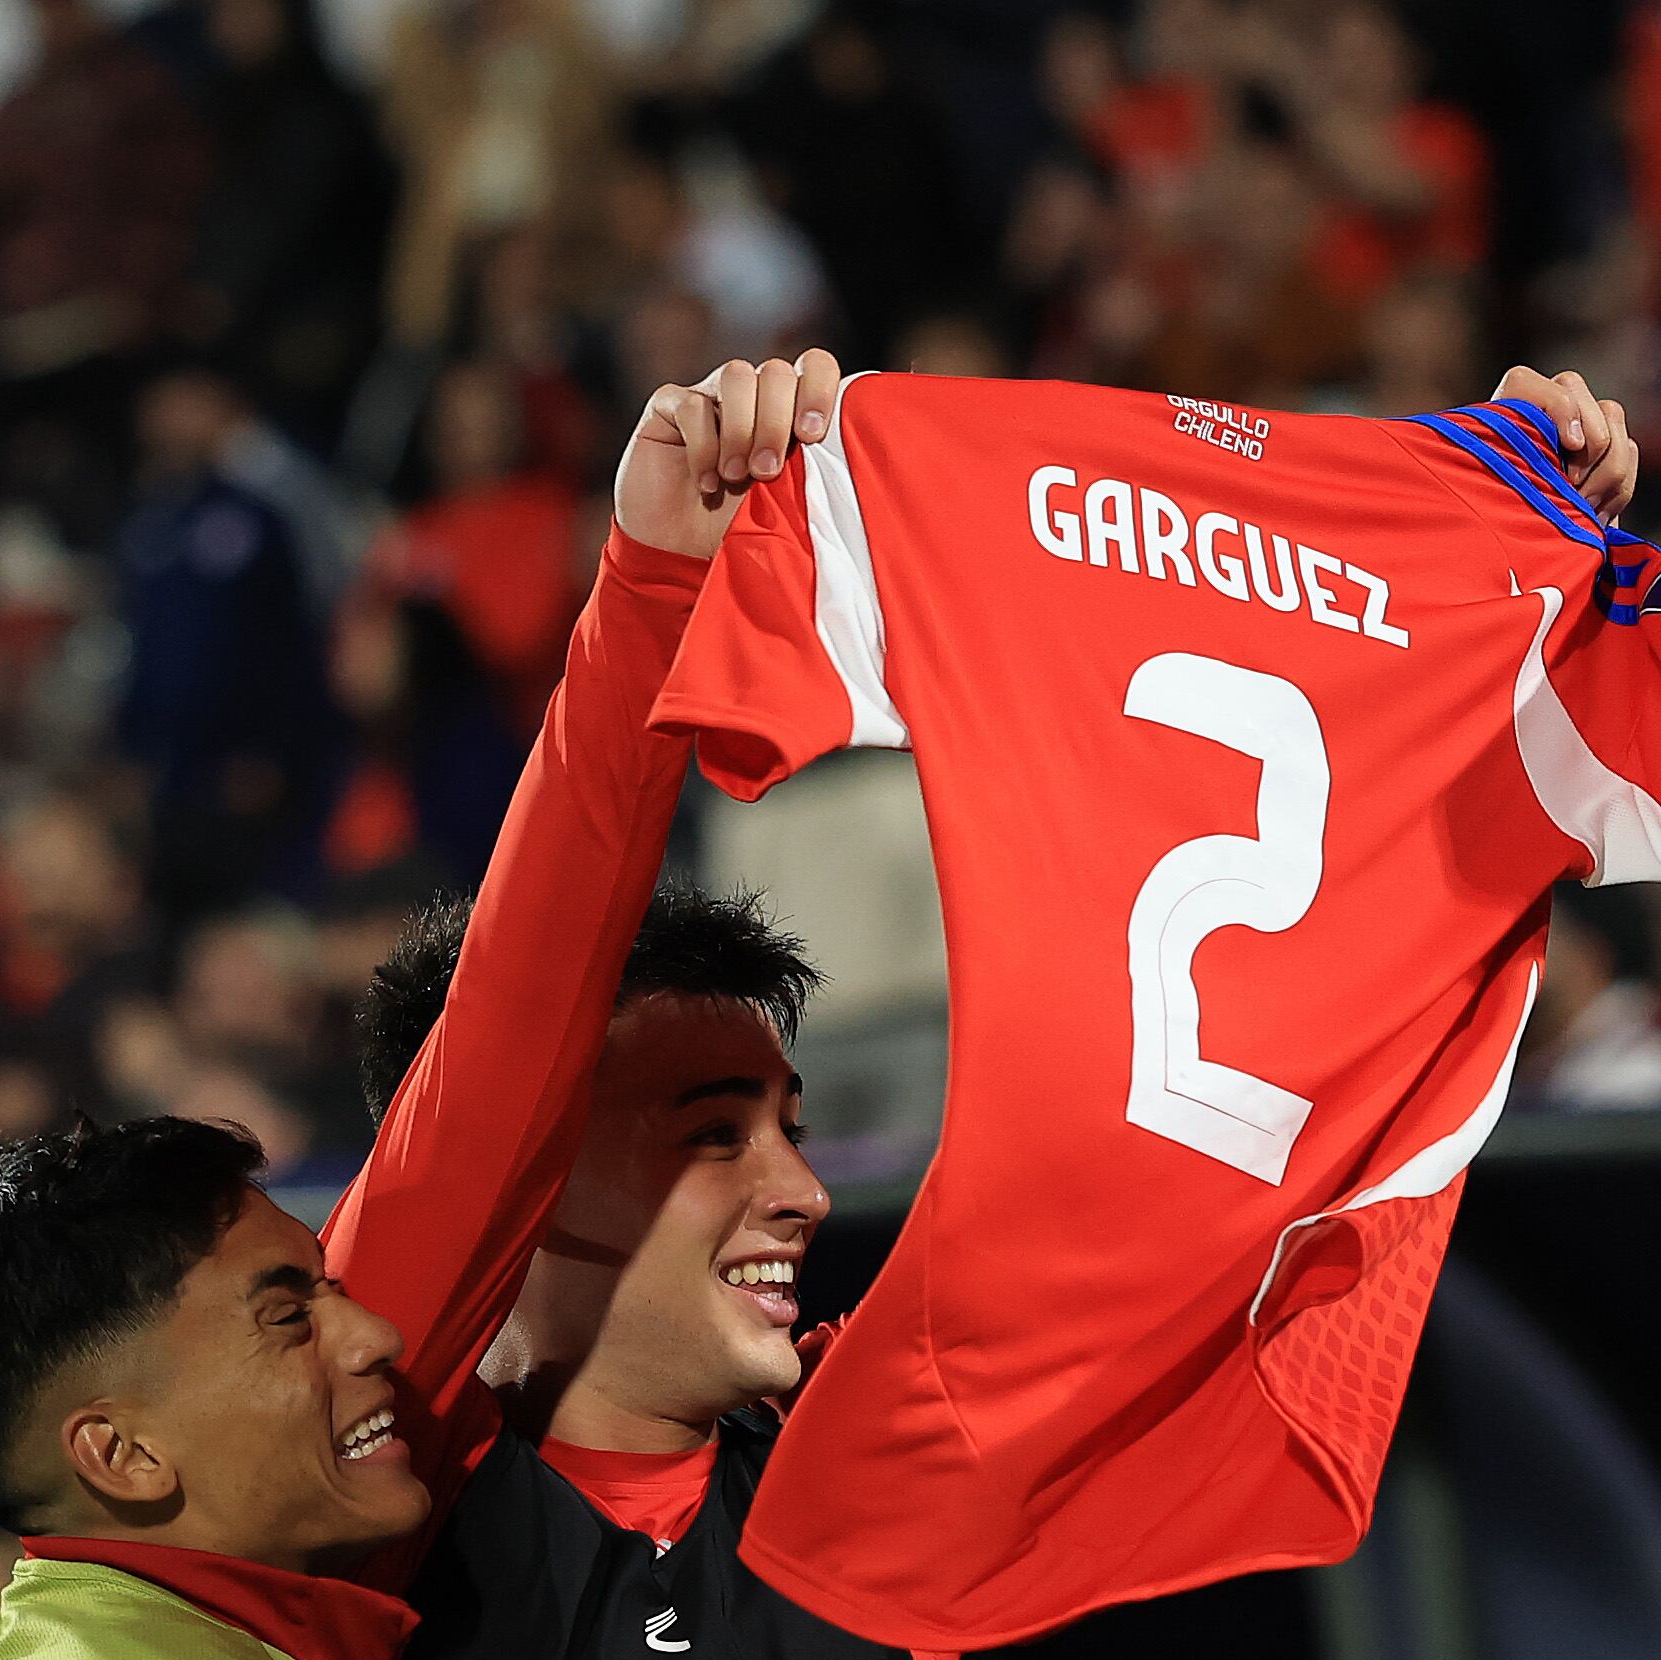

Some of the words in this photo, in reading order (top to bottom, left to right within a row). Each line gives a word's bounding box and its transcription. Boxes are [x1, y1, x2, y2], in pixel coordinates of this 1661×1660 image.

[1166, 395, 1270, 439] ORGULLO
[1174, 411, 1263, 461] CHILENO
[1027, 465, 1410, 649] GARGUEZ
[1122, 651, 1331, 1187] 2
